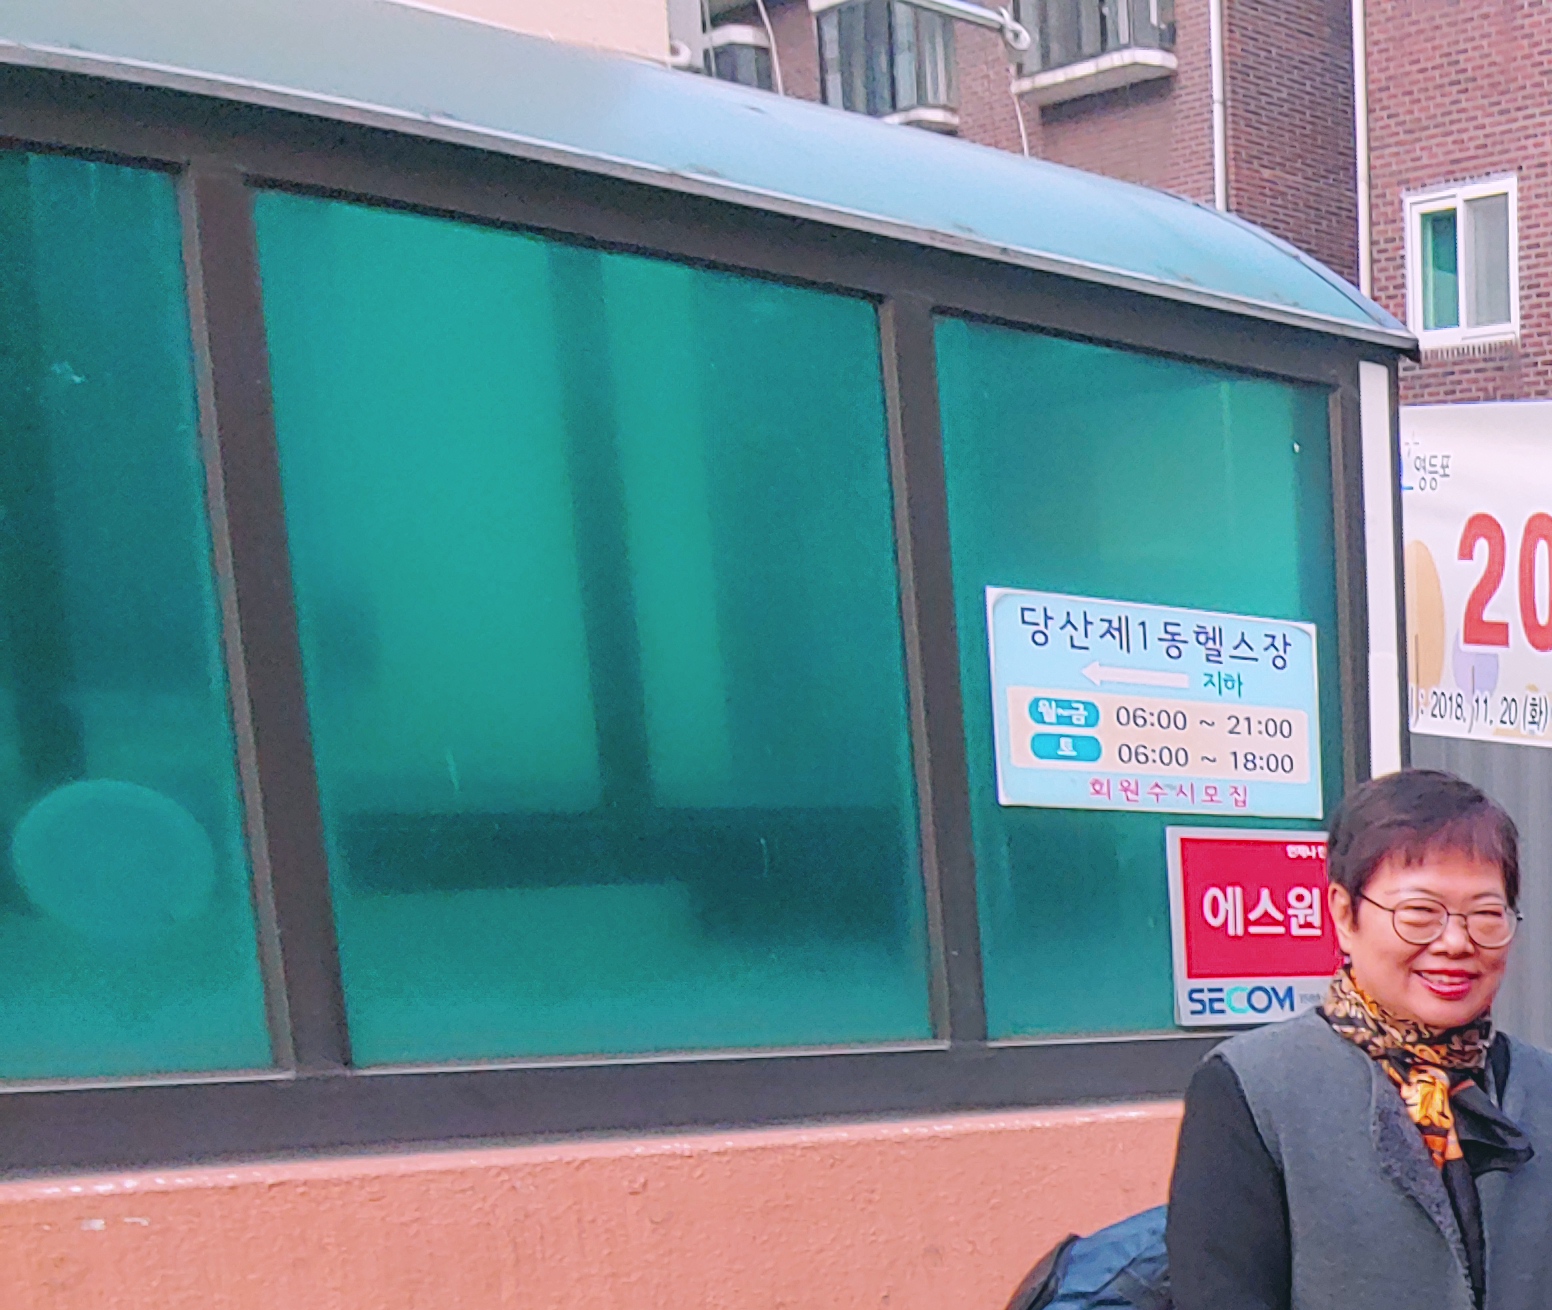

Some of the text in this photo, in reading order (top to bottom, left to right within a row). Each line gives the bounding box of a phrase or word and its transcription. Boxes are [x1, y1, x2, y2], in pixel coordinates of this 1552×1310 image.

[1413, 454, 1451, 491] 영등포
[1202, 670, 1244, 698] 지하
[1115, 705, 1188, 731] 06:00
[1226, 714, 1293, 740] 21:00
[1499, 696, 1518, 726] 20
[1056, 737, 1079, 757] 토
[1117, 743, 1190, 768] 06:00
[1229, 750, 1294, 774] 18:00
[1202, 885, 1323, 937] 에스원
[1188, 985, 1295, 1015] SECOM
